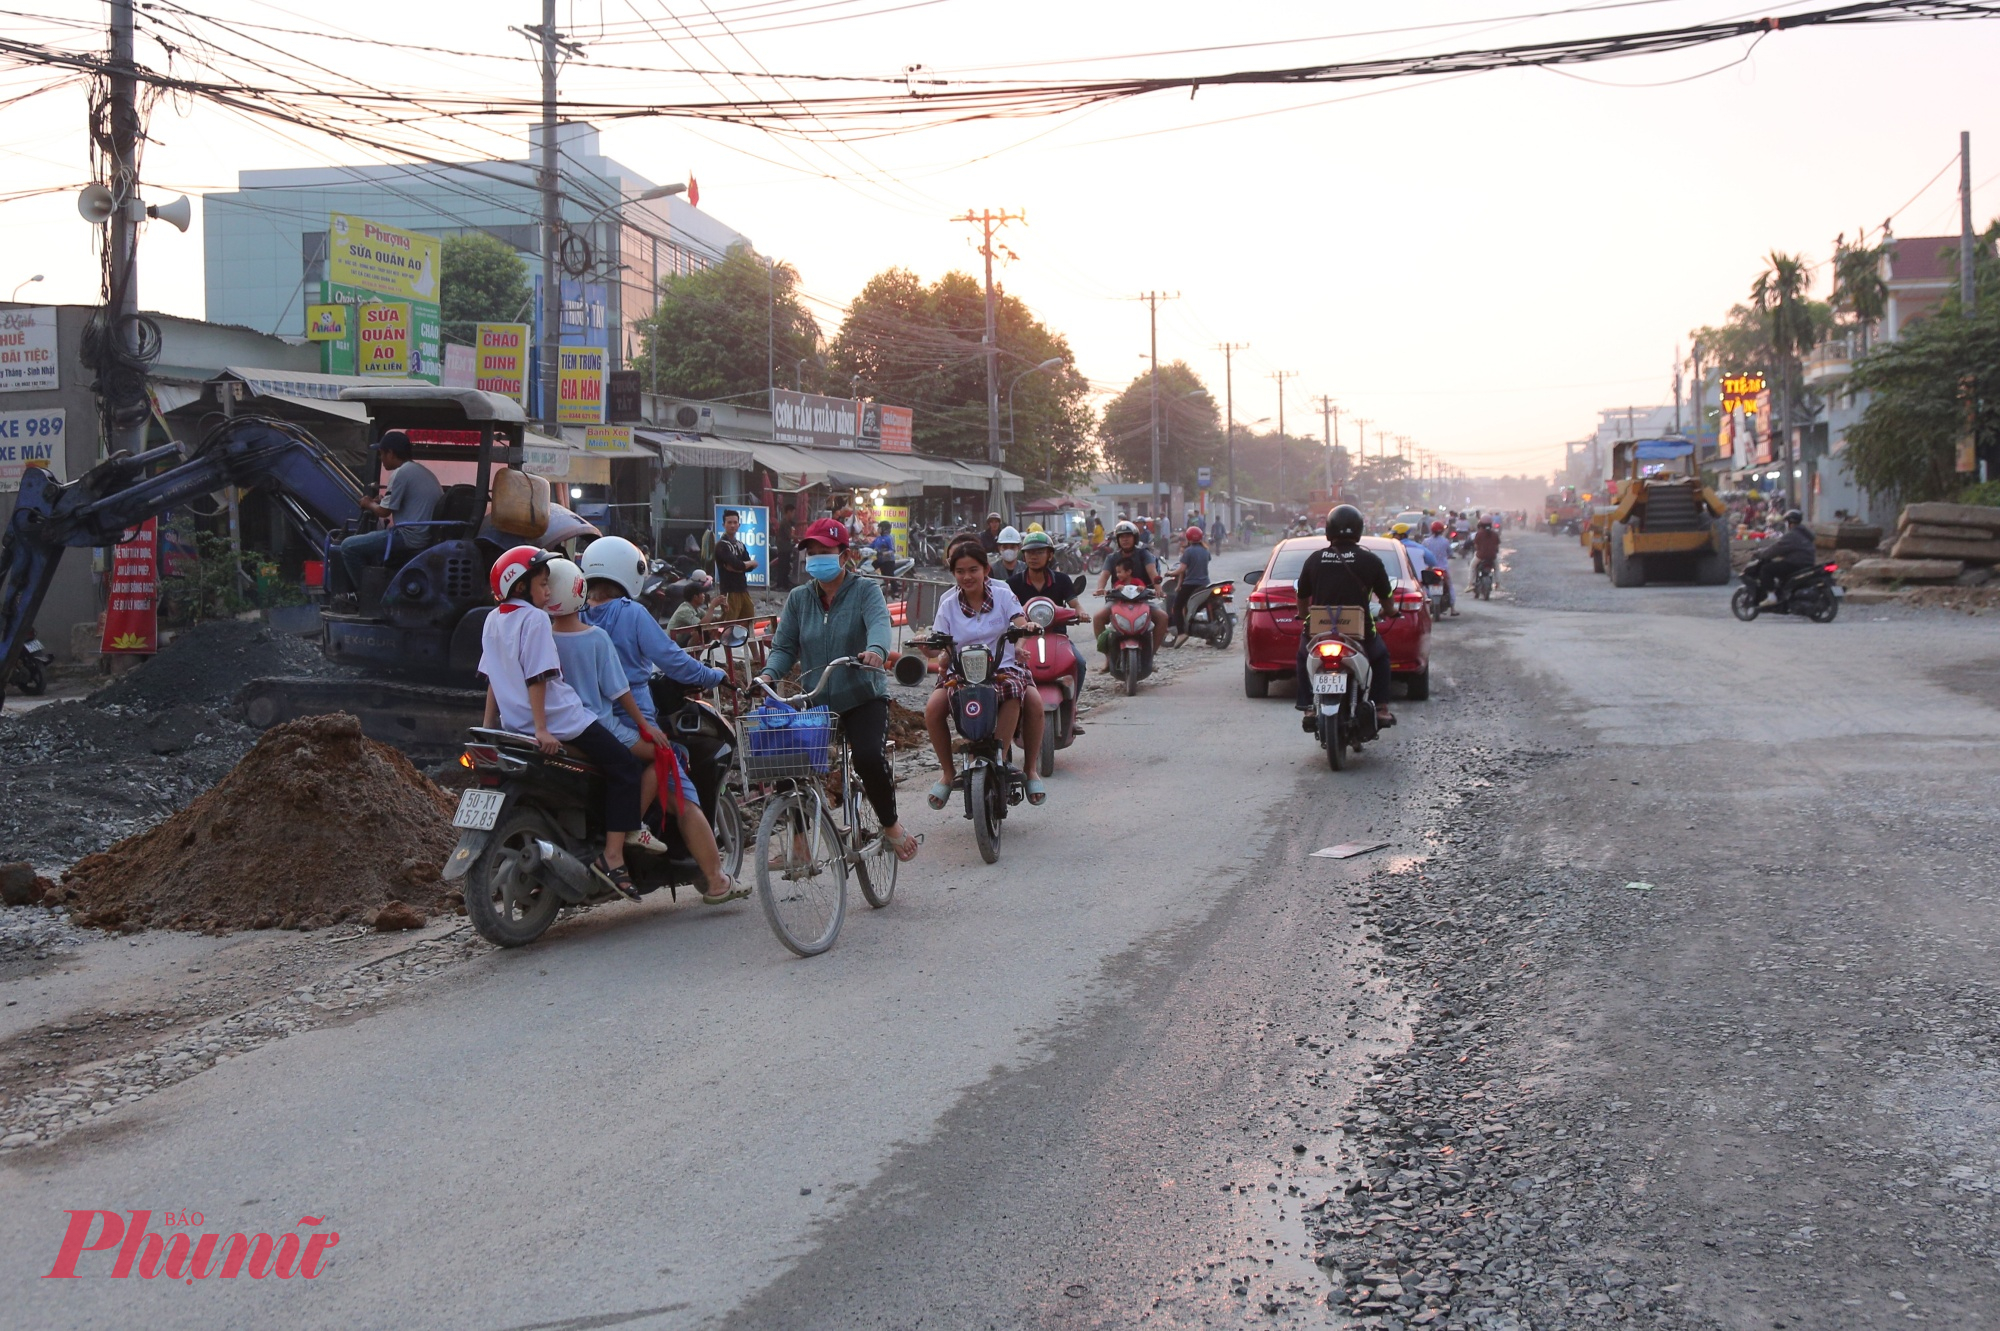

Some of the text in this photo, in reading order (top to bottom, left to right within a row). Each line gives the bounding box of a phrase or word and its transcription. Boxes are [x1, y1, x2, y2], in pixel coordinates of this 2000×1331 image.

[364, 223, 410, 250] Phượng
[349, 243, 372, 259] SỬA
[408, 257, 422, 271] ÁO
[367, 306, 400, 322] SỬA
[592, 300, 605, 329] TÂY
[312, 321, 342, 333] Panda
[420, 321, 439, 340] CHÁO
[483, 330, 519, 347] CHÁO
[24, 347, 49, 364] TIỆC
[373, 344, 395, 359] ÁO
[422, 342, 438, 358] DINH
[27, 366, 40, 376] Sinh
[41, 364, 55, 377] Nhật
[484, 356, 516, 370] DINH
[561, 352, 601, 372] TIỆM TRỨNG
[477, 376, 521, 393] DƯỠNG
[561, 376, 600, 401] GIA HÂN
[1724, 376, 1762, 396] TIỆM
[775, 400, 794, 430] CƠM
[794, 396, 812, 431] TẤM
[813, 402, 836, 433] XUÂN
[837, 405, 855, 436] BÌNH
[26, 417, 63, 437] 989
[0, 441, 53, 461] XE MÁY
[736, 507, 757, 525] HÀ
[745, 573, 765, 582] ANG
[1315, 683, 1345, 693] 487.14
[1318, 675, 1342, 684] 68-E1
[466, 792, 497, 811] 50-X1
